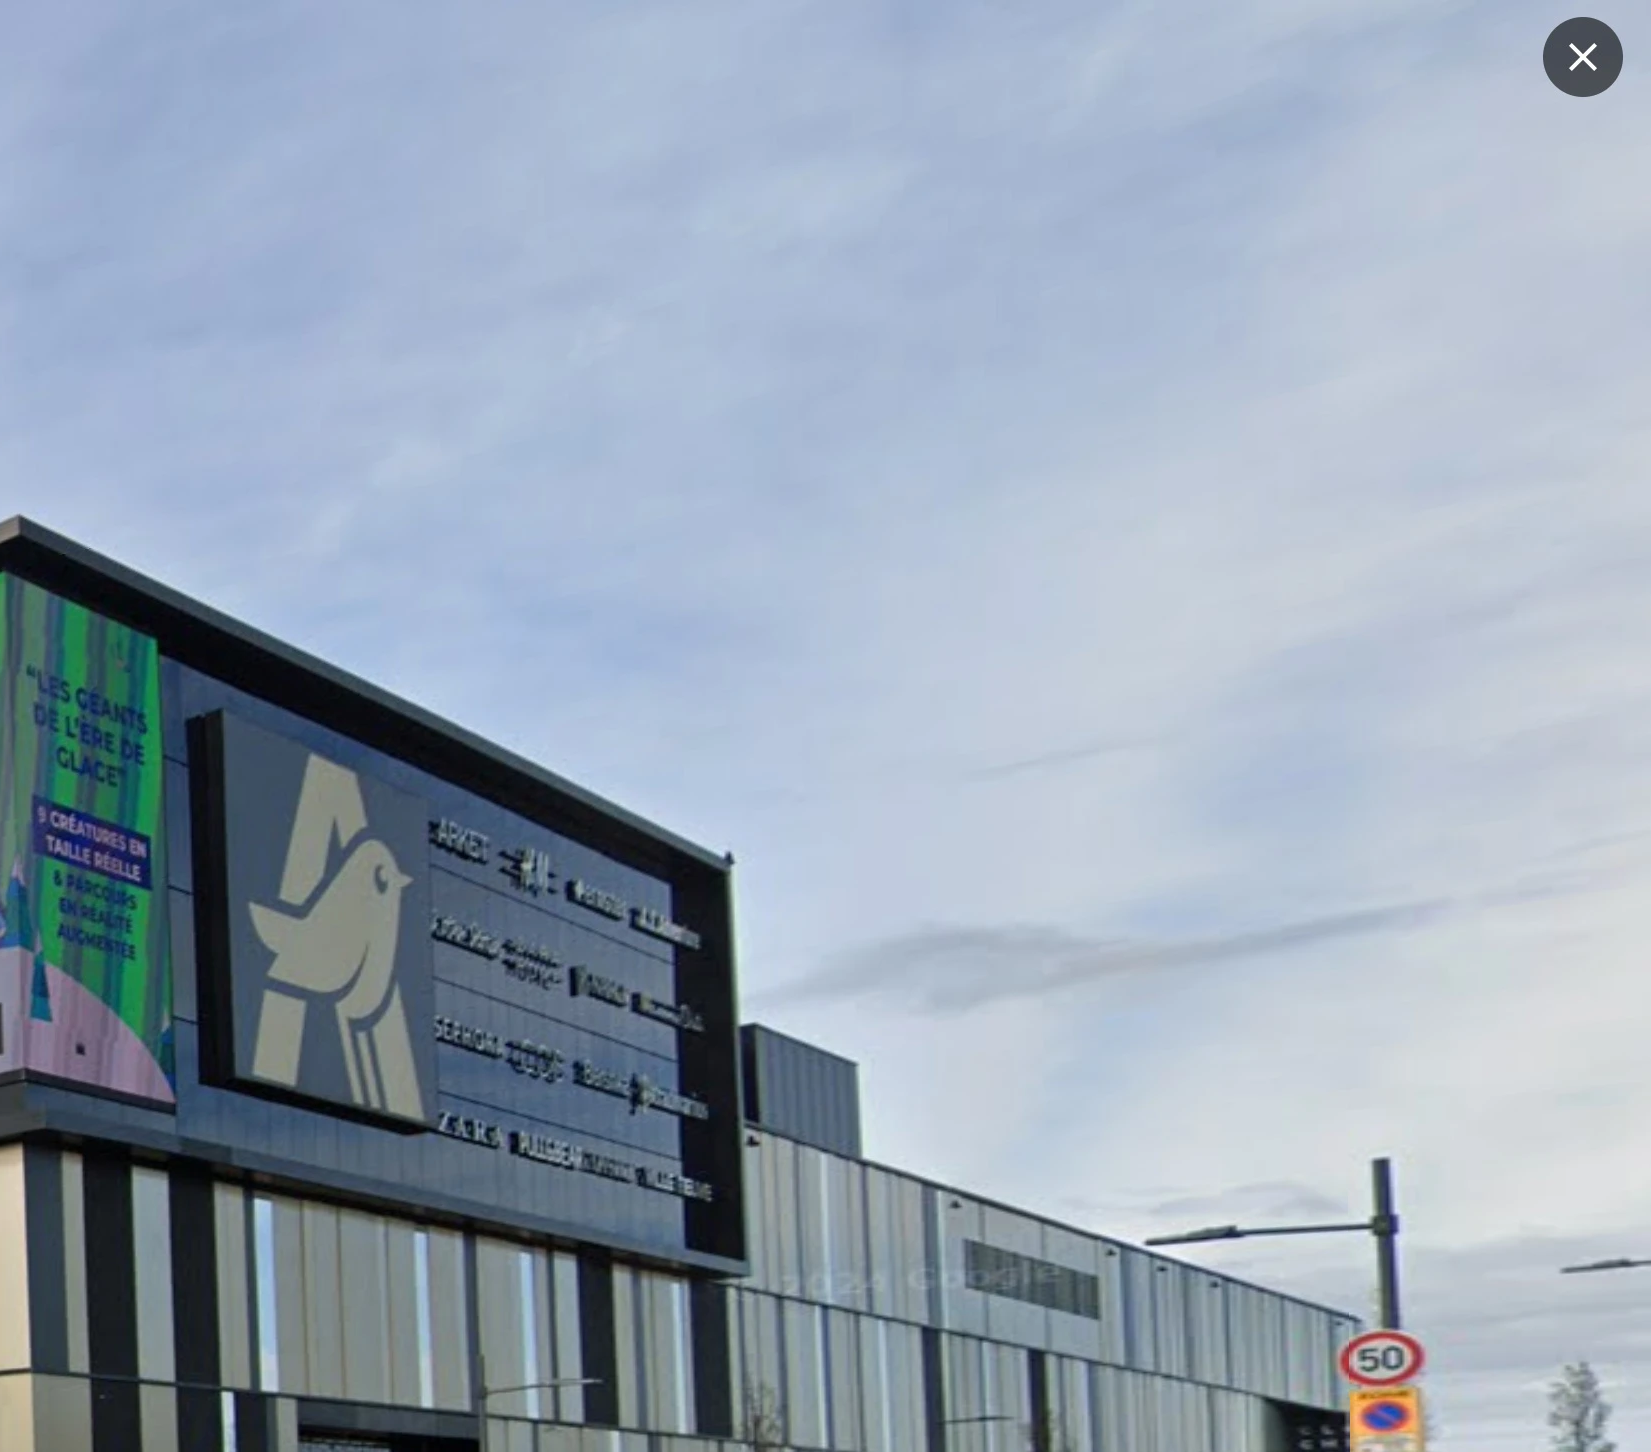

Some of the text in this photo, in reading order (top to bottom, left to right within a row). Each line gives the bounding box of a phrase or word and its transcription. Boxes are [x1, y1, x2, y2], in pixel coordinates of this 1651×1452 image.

[34, 702, 59, 733] DE
[121, 737, 145, 766] DE
[75, 686, 147, 735] GÉANTS
[46, 834, 141, 882] TAILLE RÉELLE
[50, 811, 126, 851] CRÉATURES
[128, 837, 147, 858] EN
[438, 1108, 505, 1149] ZARA
[1358, 1344, 1405, 1373] 50
